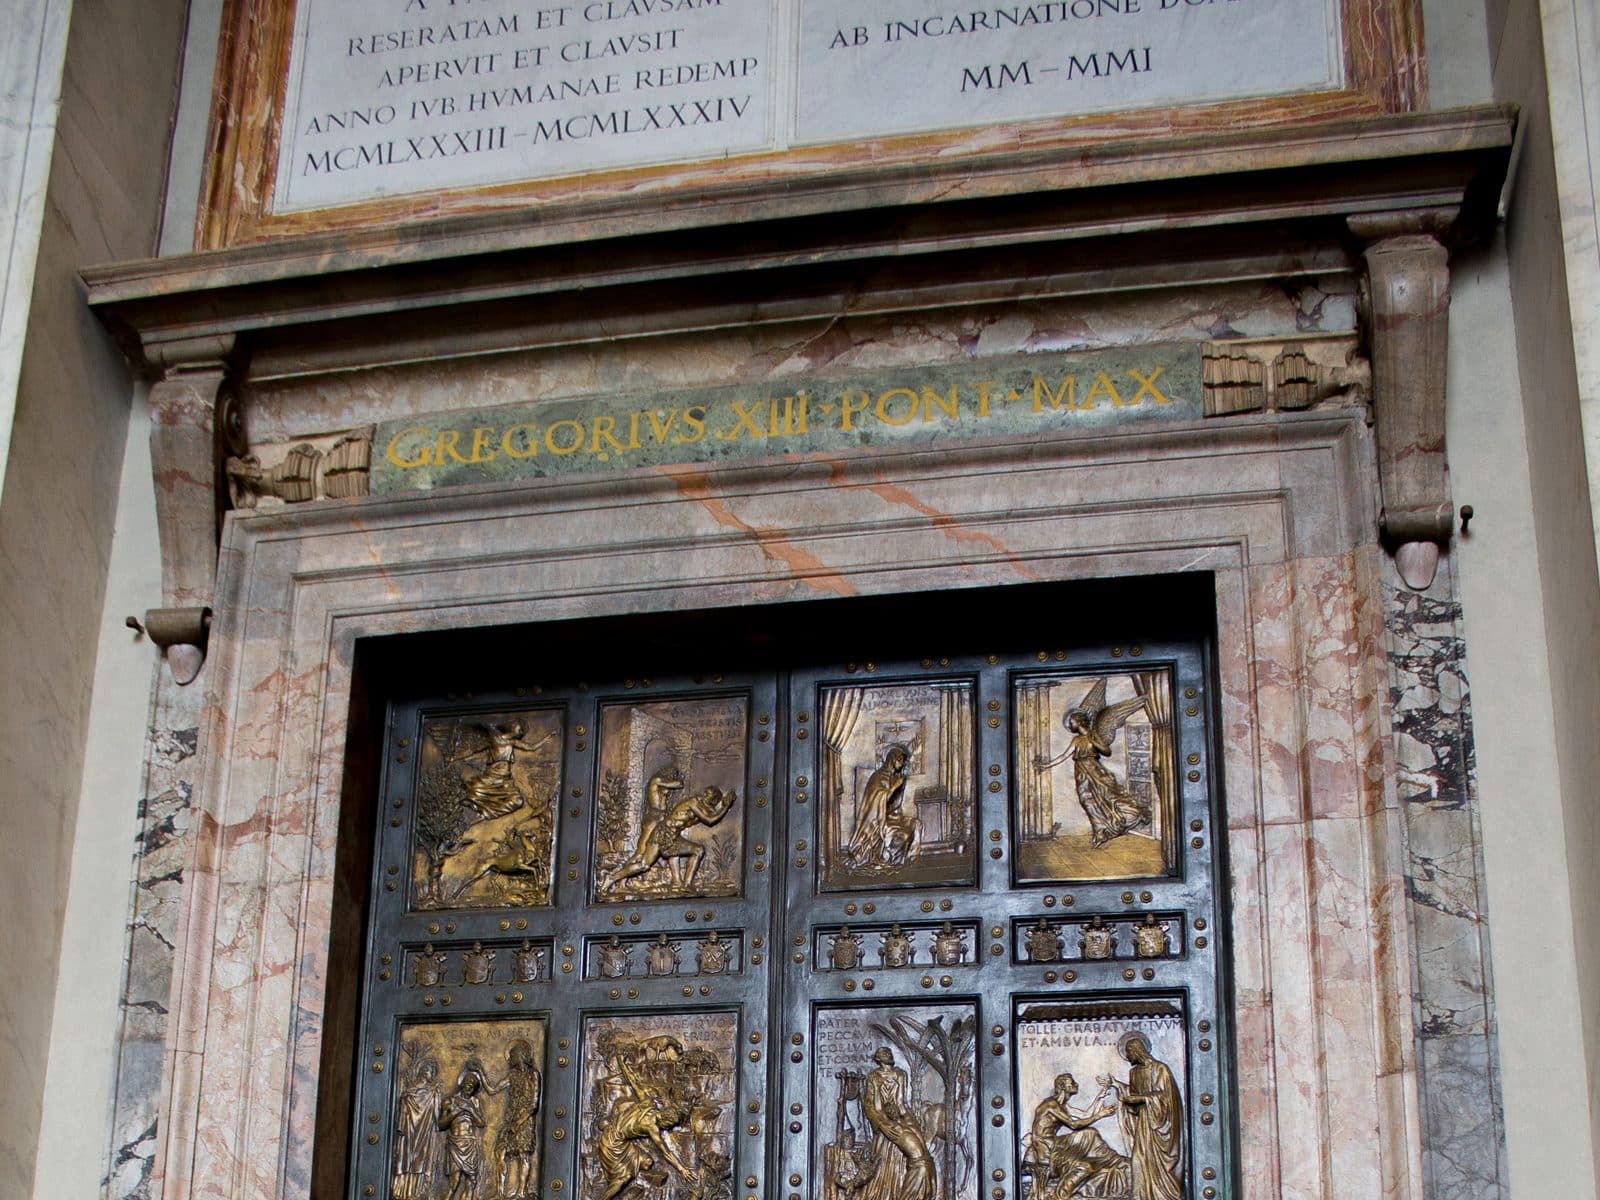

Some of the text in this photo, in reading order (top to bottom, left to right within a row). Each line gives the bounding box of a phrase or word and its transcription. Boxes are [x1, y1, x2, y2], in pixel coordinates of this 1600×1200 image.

[348, 14, 519, 56] RESERATAM
[536, 8, 572, 30] ET
[829, 0, 1141, 49] AB INCARNATIONE
[377, 28, 686, 89] APERVIT ET CLAVSIT
[960, 61, 1032, 92] MM
[1067, 47, 1153, 81] MMI
[305, 104, 396, 135] ANNO
[468, 75, 621, 112] HVMANAE
[819, 1018, 859, 1030] PATER
[820, 1067, 833, 1078] TE
